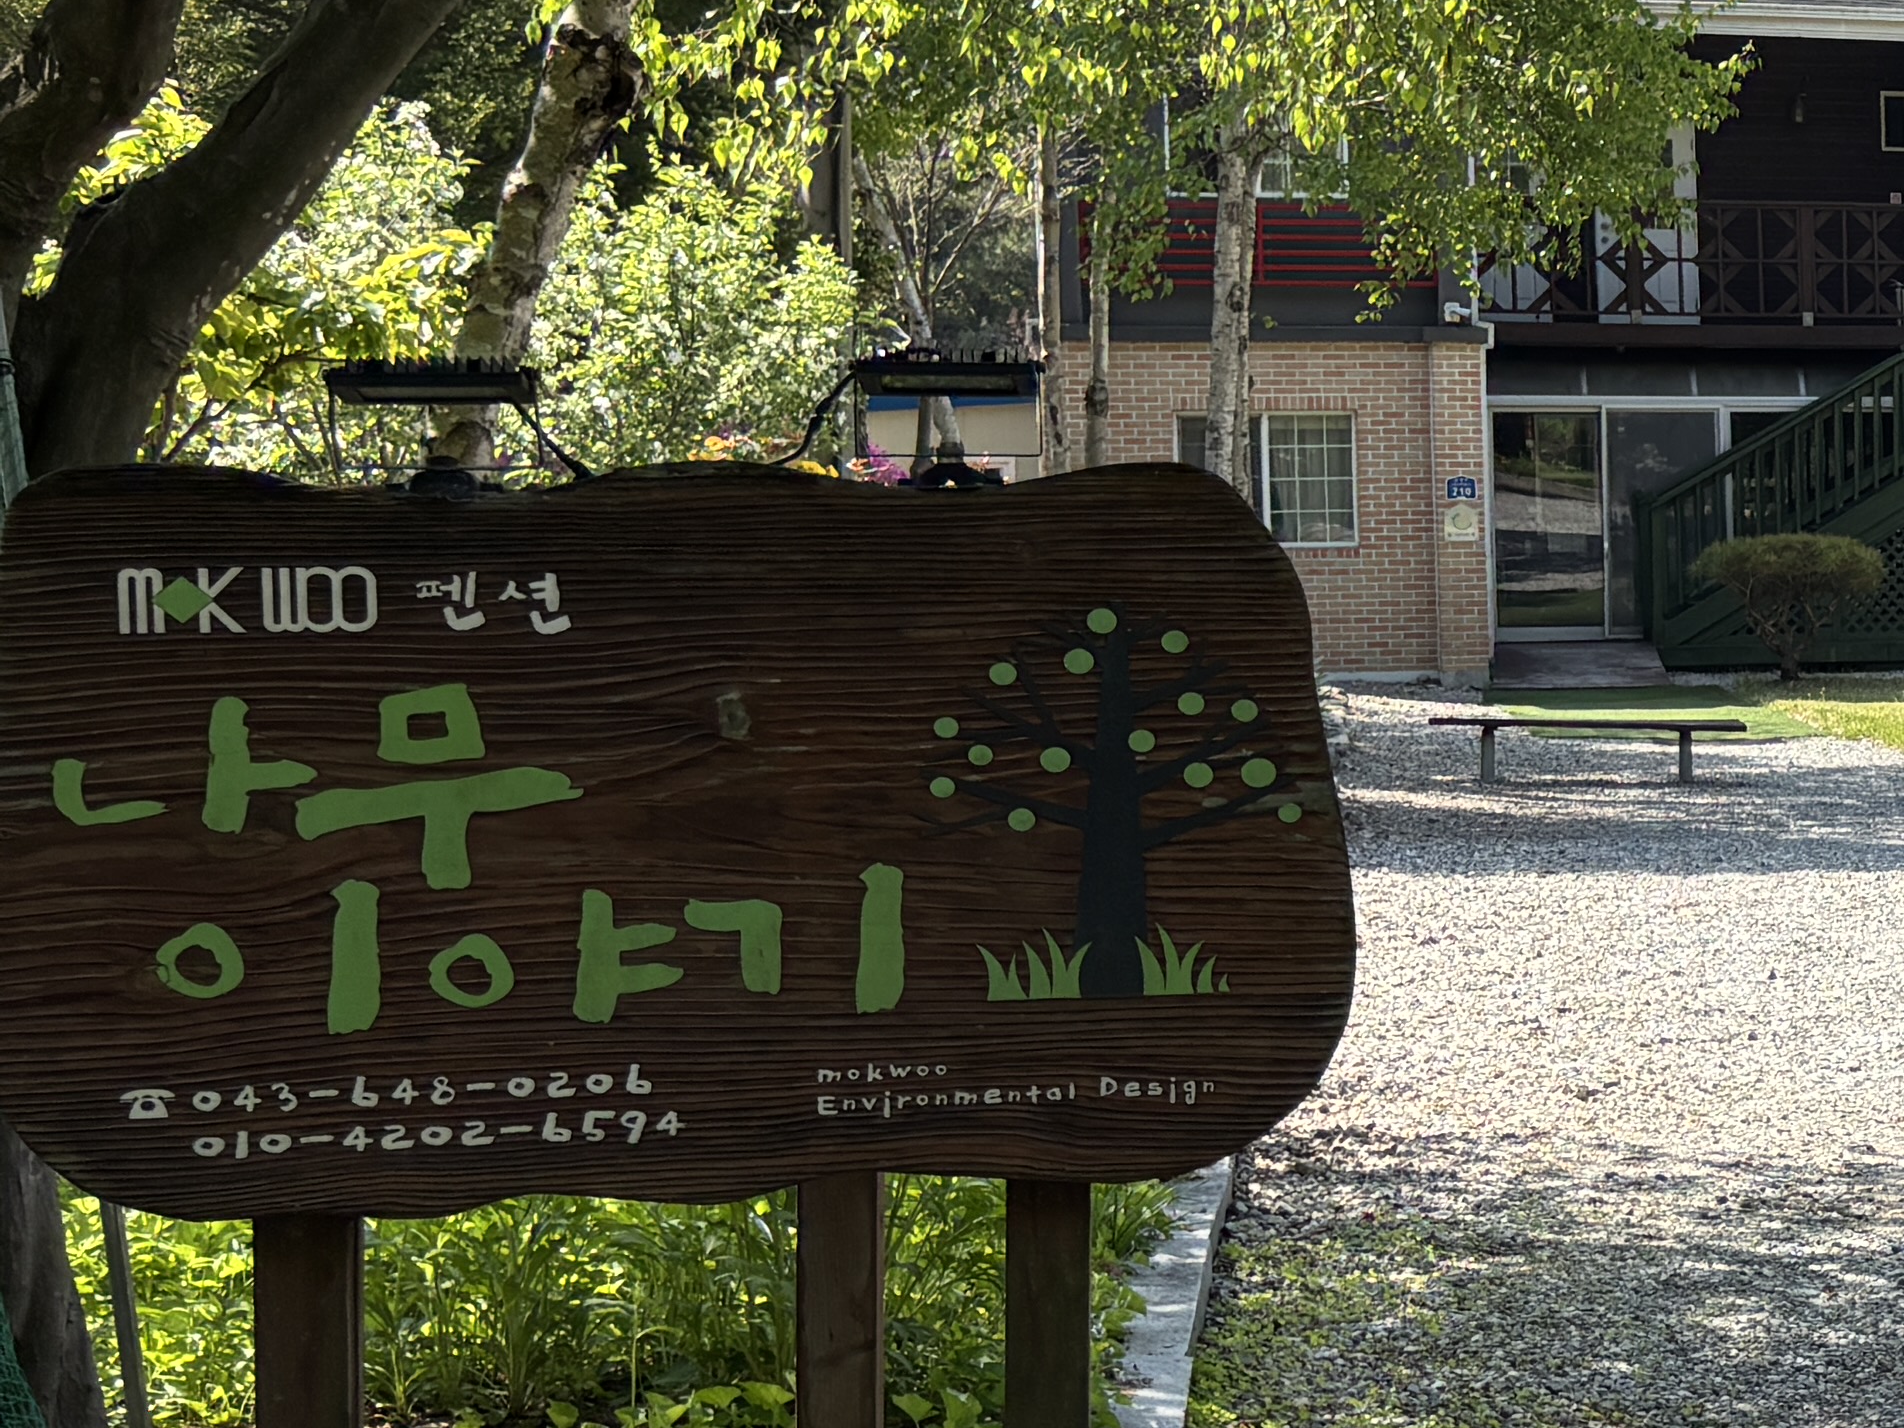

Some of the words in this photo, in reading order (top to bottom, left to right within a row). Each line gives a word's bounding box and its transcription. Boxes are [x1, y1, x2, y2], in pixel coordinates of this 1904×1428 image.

[415, 571, 572, 635] 펜션
[51, 683, 585, 890] 나무
[155, 862, 906, 1035] 이야기
[192, 1063, 652, 1112] 043-648-0206
[817, 1063, 947, 1083] mokwoo
[817, 1082, 1076, 1118] Environmental
[1100, 1075, 1216, 1105] Design
[192, 1110, 686, 1160] 010-4202-6594
